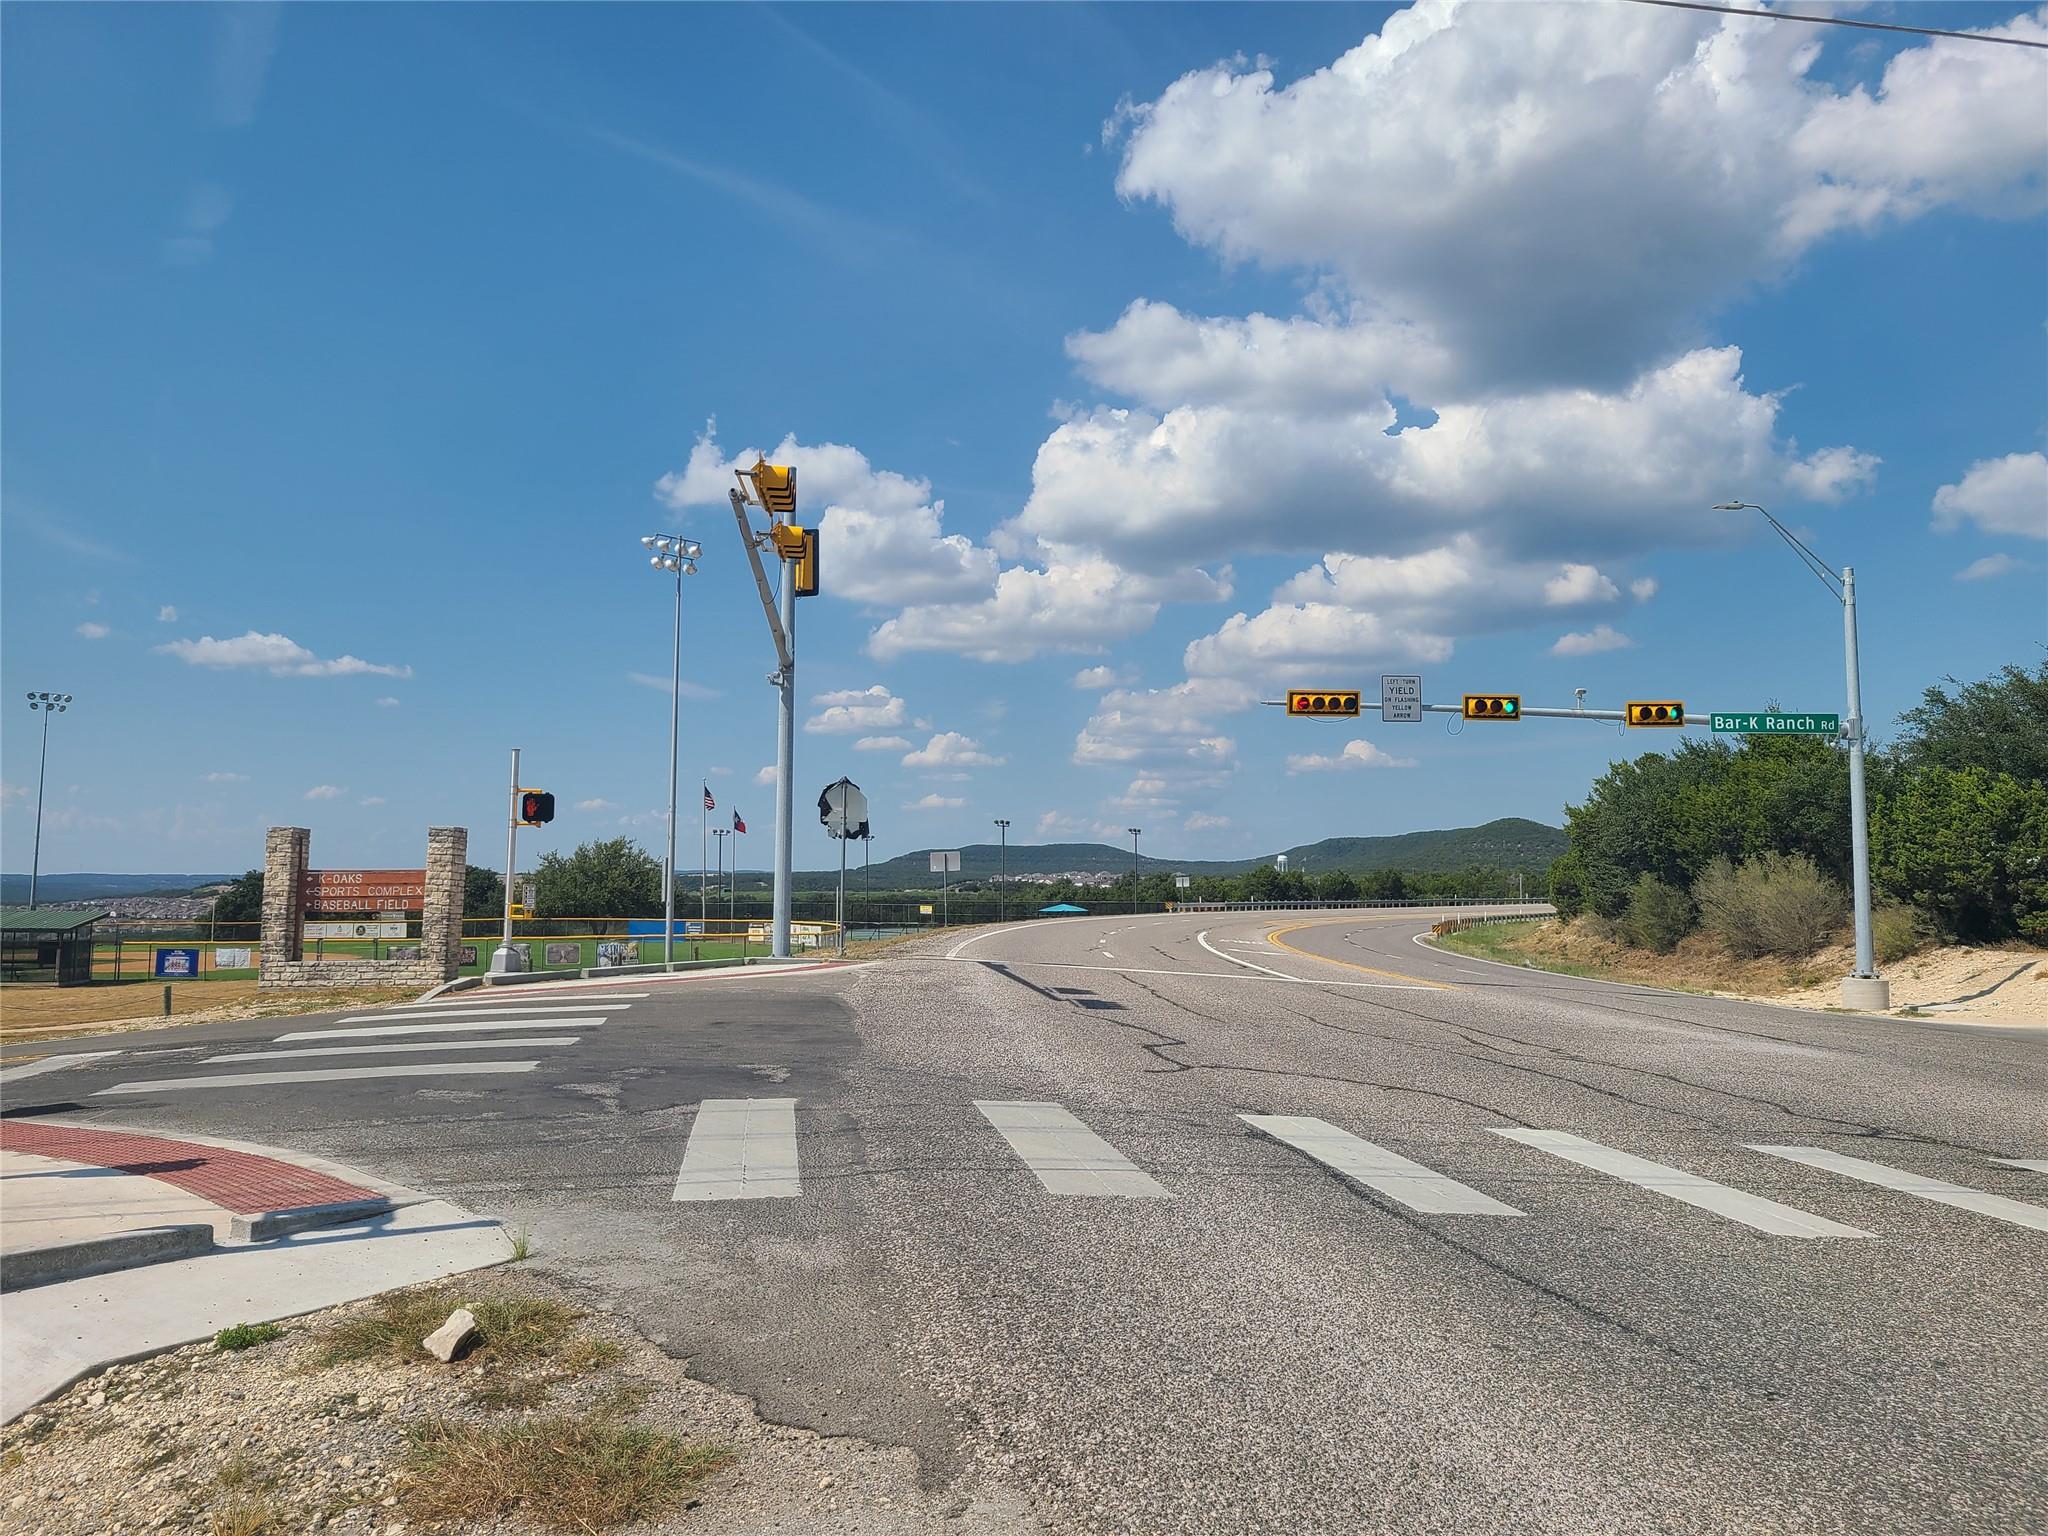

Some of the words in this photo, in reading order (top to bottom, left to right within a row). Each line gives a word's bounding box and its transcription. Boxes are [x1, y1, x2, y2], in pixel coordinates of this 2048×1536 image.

[1389, 686, 1415, 695] YIELD
[1714, 716, 1759, 730] Bar-K
[1766, 716, 1815, 730] Ranch
[1820, 720, 1835, 730] Rd
[319, 874, 363, 884] K-OAKS
[314, 886, 360, 897] SPORTS
[367, 886, 423, 896] COMPLEX
[314, 899, 372, 910] BASEBALL
[377, 899, 409, 910] FIELD
